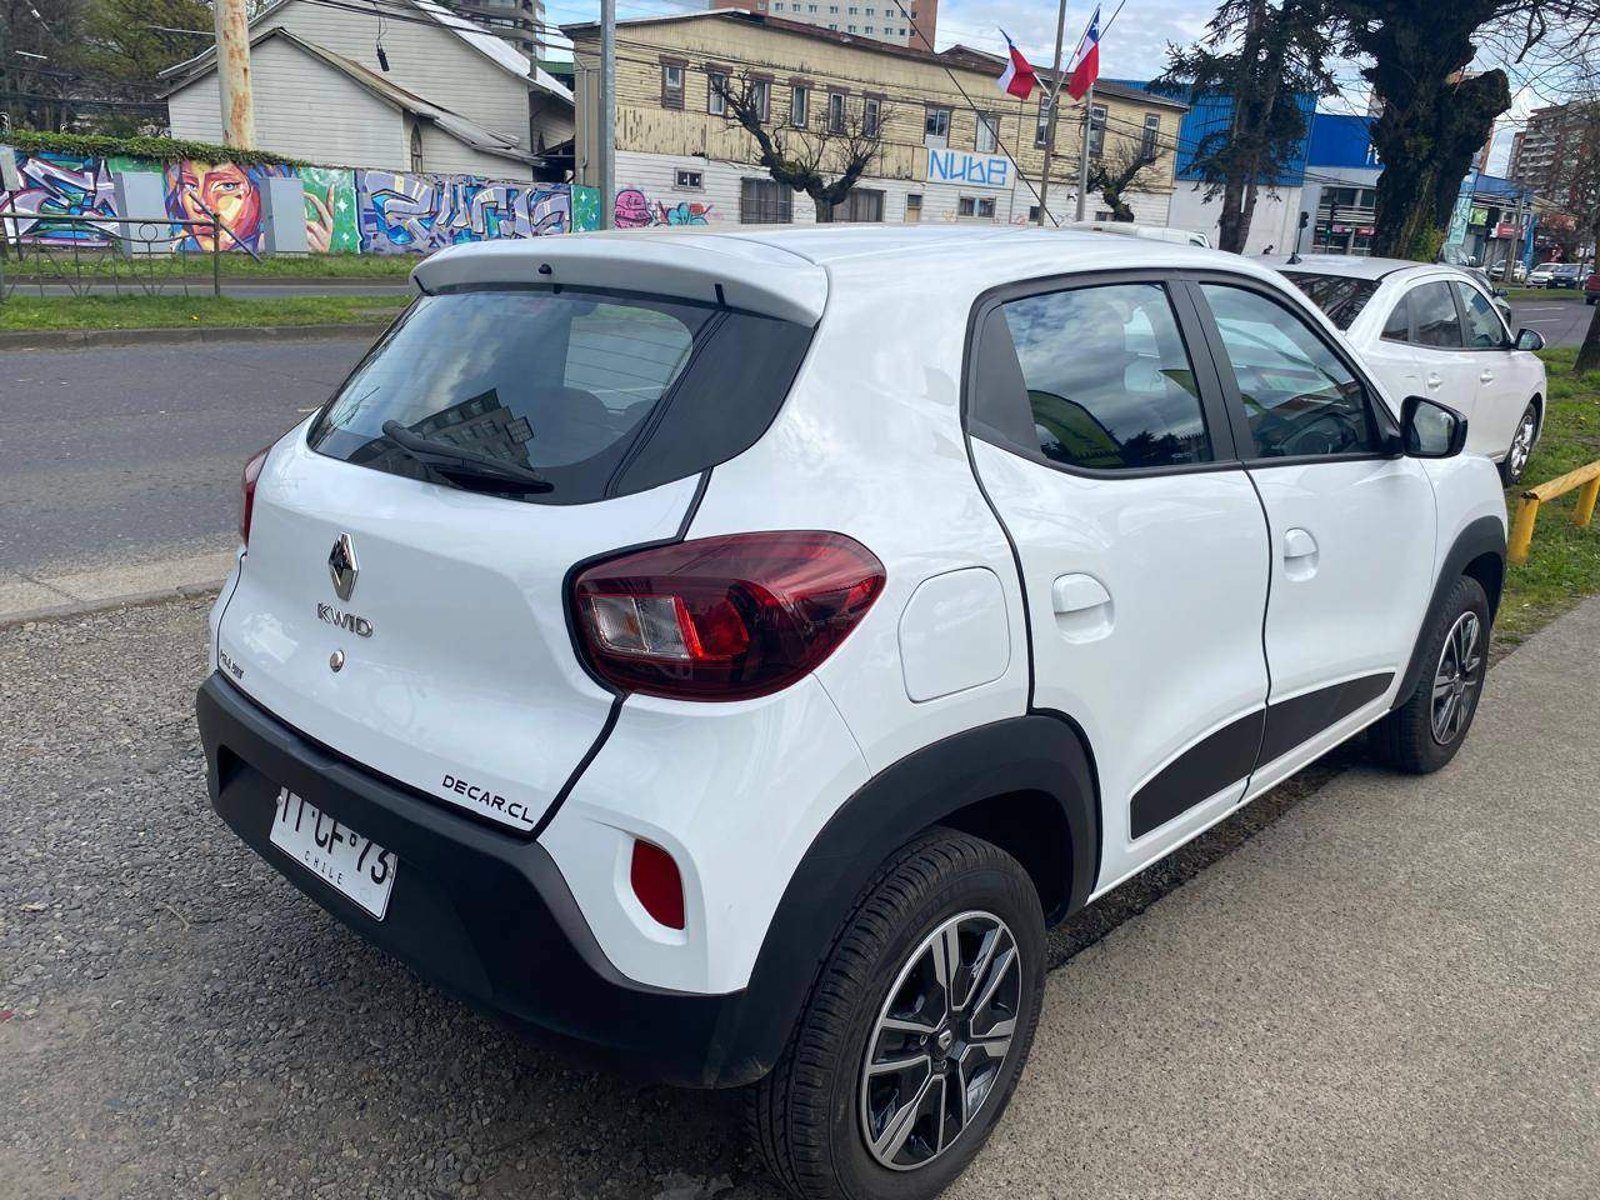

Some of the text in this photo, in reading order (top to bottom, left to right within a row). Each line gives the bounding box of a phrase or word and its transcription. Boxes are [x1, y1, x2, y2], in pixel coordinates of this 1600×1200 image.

[317, 602, 374, 639] KWID
[442, 774, 535, 825] DECAR.CL
[304, 850, 343, 885] CHILE
